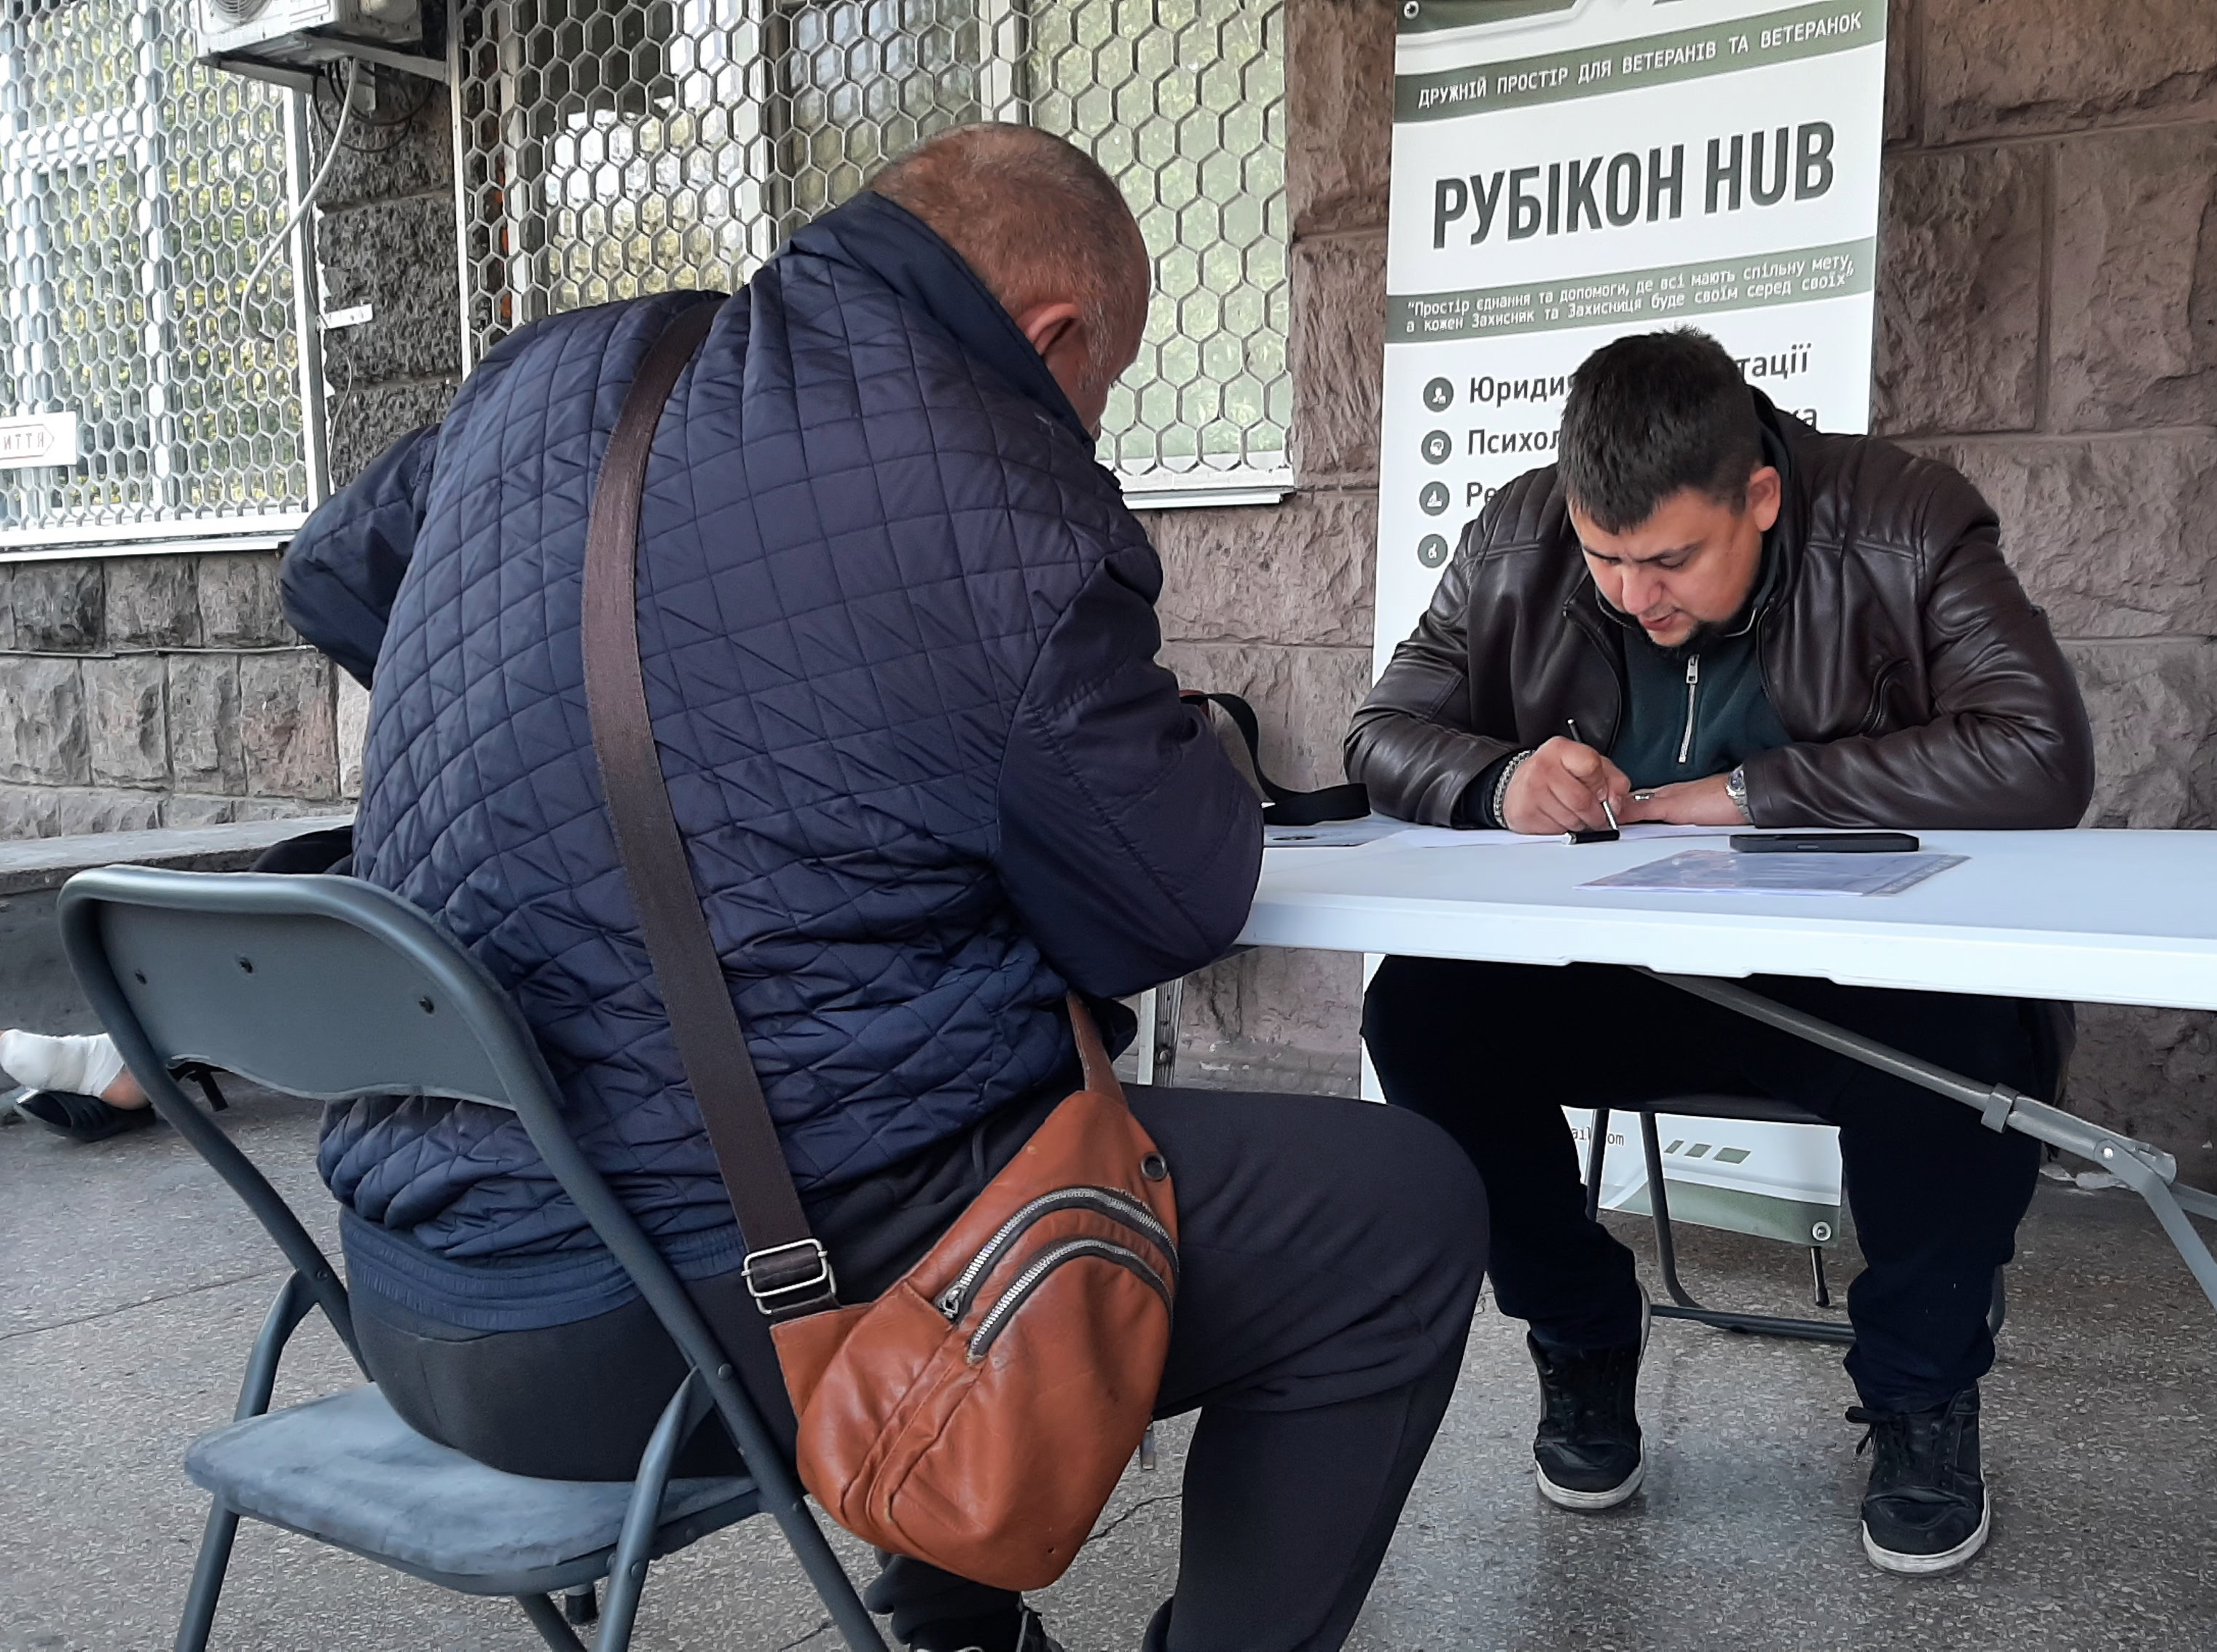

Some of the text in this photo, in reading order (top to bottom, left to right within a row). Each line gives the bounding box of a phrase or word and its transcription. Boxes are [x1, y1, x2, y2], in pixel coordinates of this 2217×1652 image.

[1418, 10, 1863, 109] ДРУЖНІЙ ПРОСТІР ДЛЯ ВЕТЕРАНІВ ТА ВЕТЕРАНОК
[1433, 122, 1835, 250] РУБІКОН HUB
[1406, 319, 1415, 334] а
[1424, 316, 1464, 333] кожен
[1544, 307, 1559, 321] та
[1567, 297, 1643, 320] Захисниця
[1650, 291, 1685, 312] буде
[1694, 283, 1738, 305] своїм
[1746, 280, 1792, 301] серед
[1477, 294, 1531, 312] єднання
[1539, 289, 1553, 304] та
[1558, 282, 1630, 305] допомоги,
[1635, 279, 1653, 297] де
[1660, 272, 1685, 291] всі
[1691, 268, 1736, 286] мають
[1743, 259, 1806, 281] спільну
